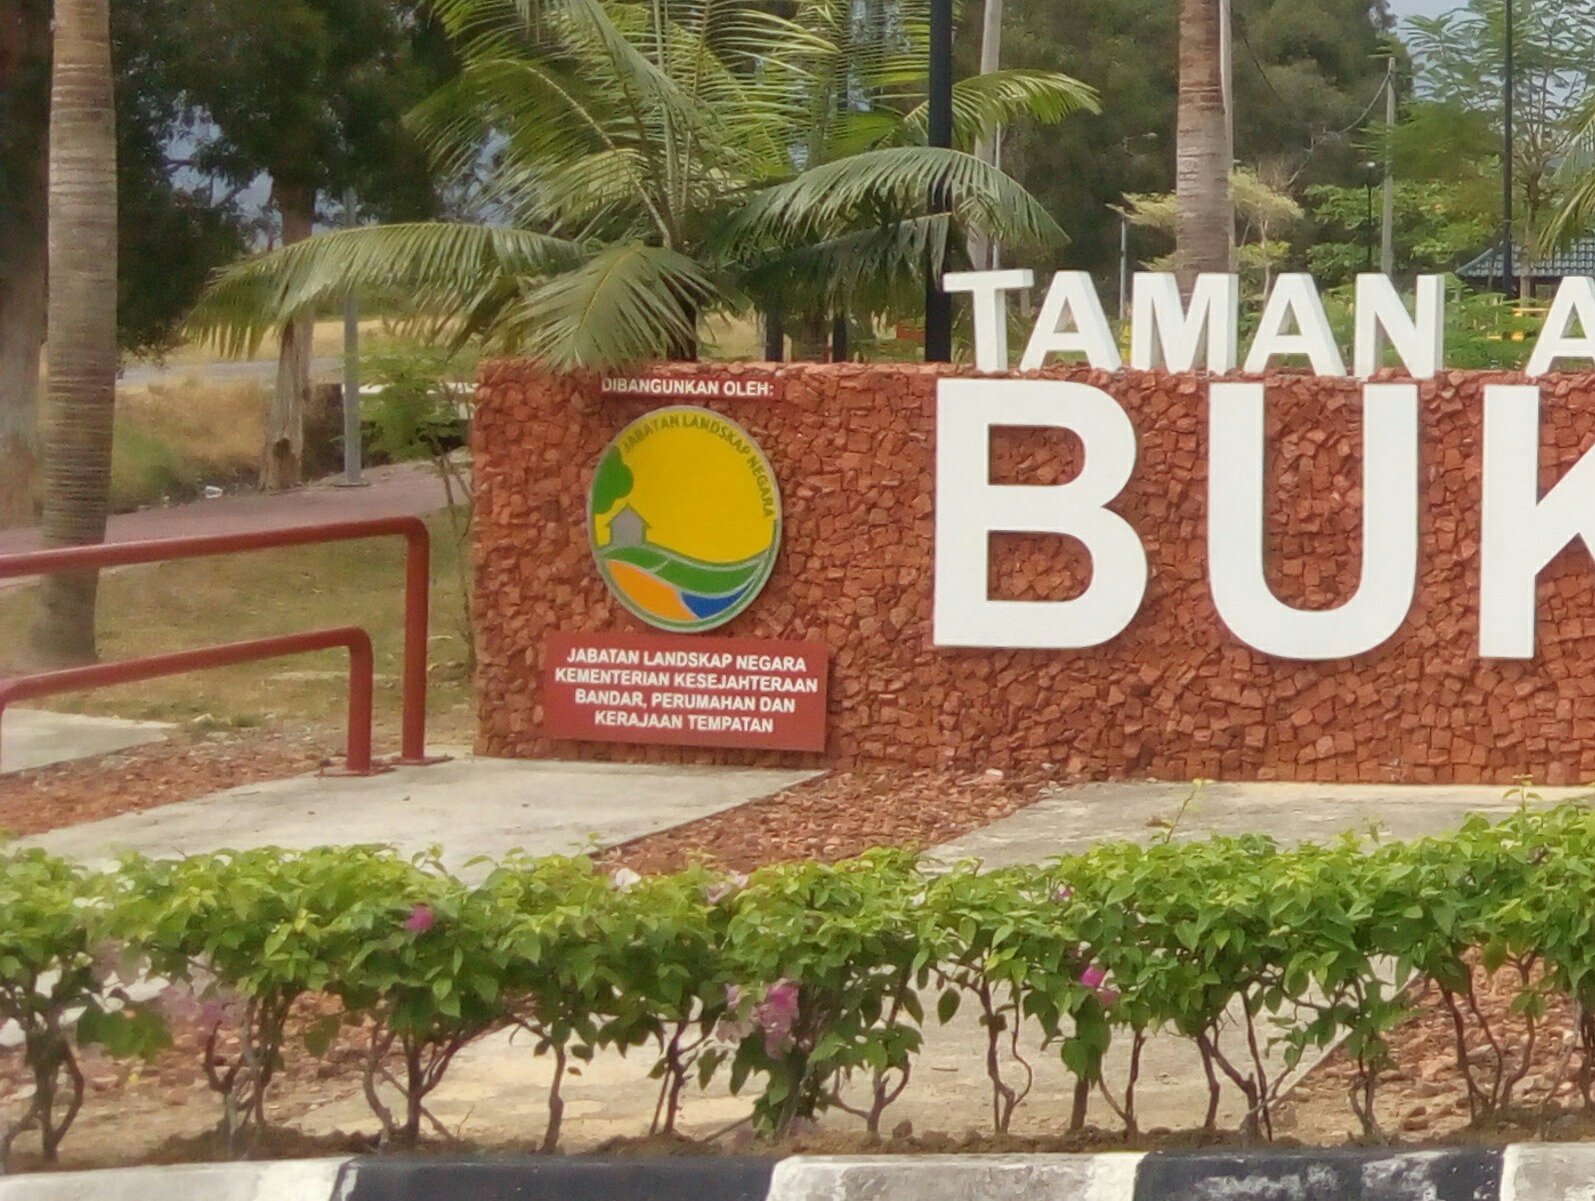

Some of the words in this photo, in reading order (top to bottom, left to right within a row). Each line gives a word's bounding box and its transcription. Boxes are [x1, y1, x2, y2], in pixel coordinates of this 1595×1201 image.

[943, 269, 1445, 379] TAMAN
[601, 377, 719, 395] DIBANGUNKAN
[723, 380, 775, 397] OLEH:
[623, 414, 680, 454] JABATAN
[682, 414, 750, 455] LANDSKAP
[747, 456, 775, 518] NEGARA
[567, 648, 640, 665] JABATAN
[643, 650, 733, 668] LANDSKAP
[736, 655, 807, 672] NEGARA
[555, 667, 670, 687] KEMENTERIAN
[673, 673, 818, 693] KESEJAHTERAAN
[575, 688, 648, 710] BANDAR,
[651, 692, 756, 711] PERUMAHAN
[759, 697, 796, 713] DAN
[594, 710, 683, 729] KERAJAAN
[687, 714, 775, 733] TEMPATAN
